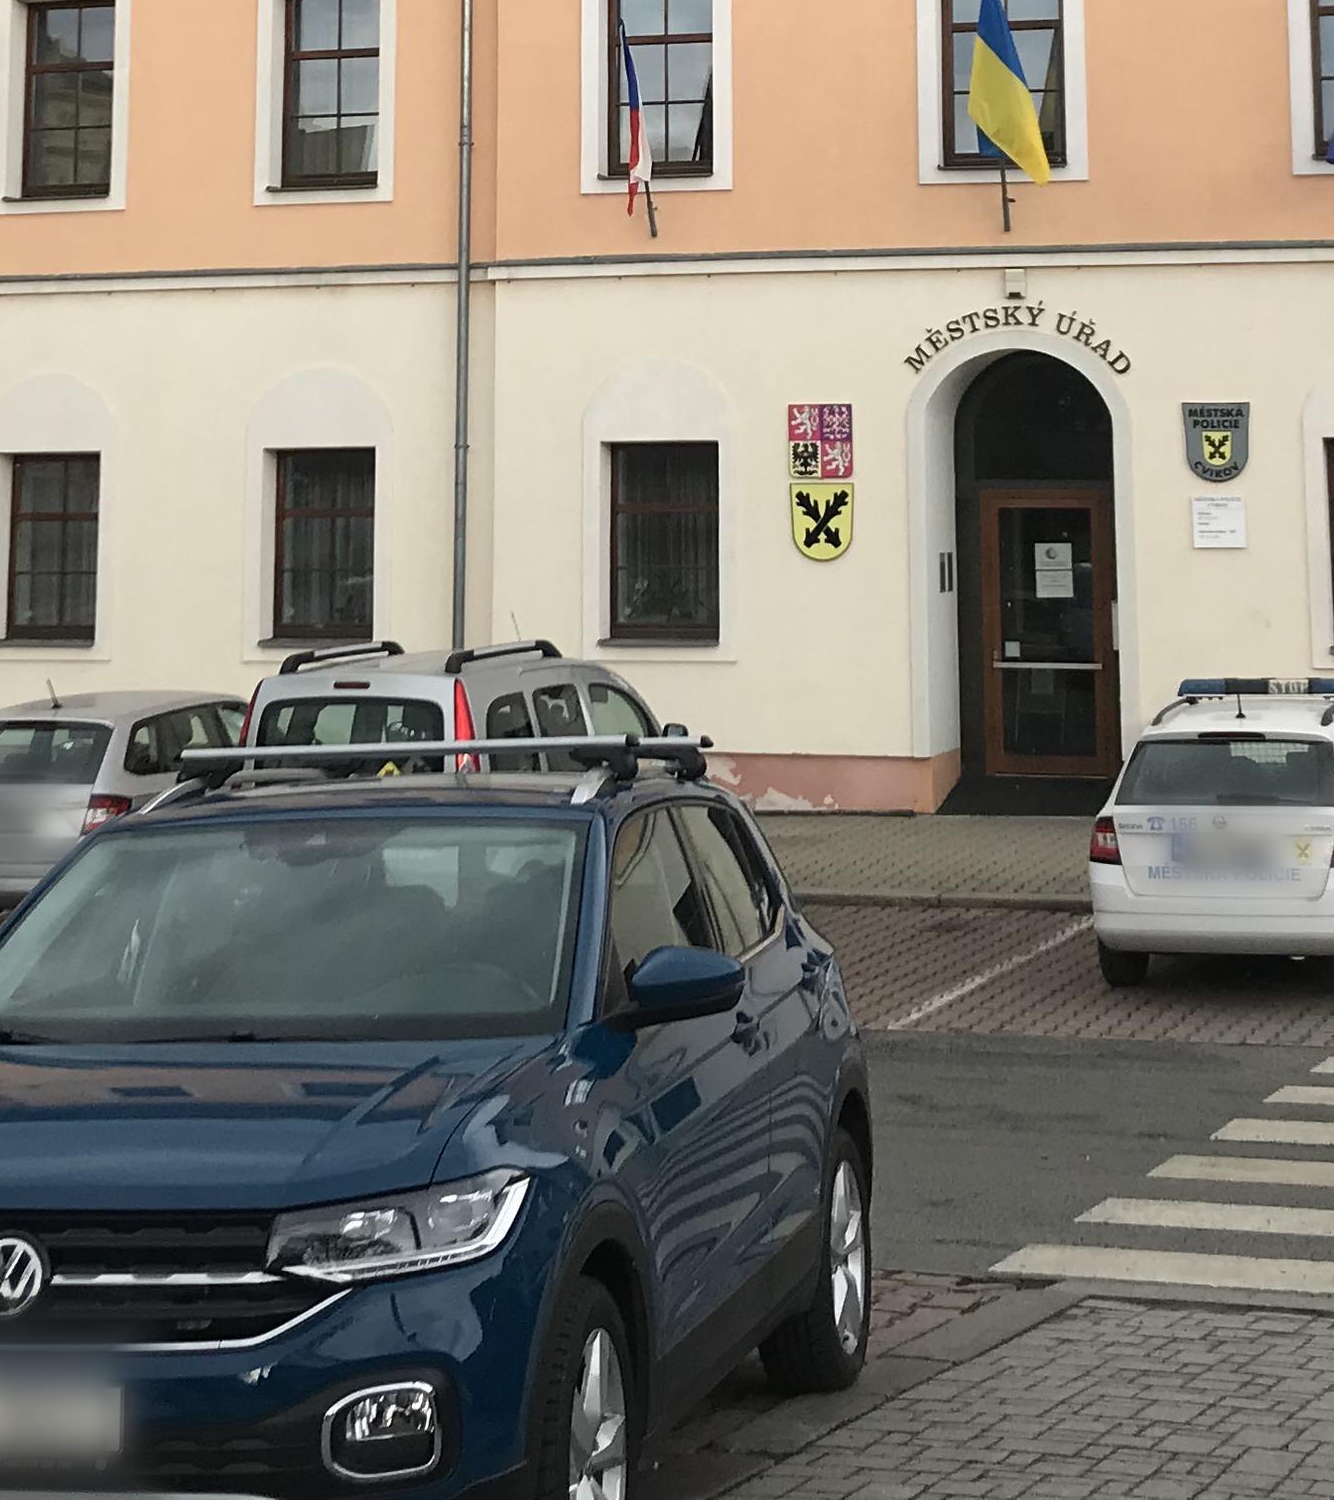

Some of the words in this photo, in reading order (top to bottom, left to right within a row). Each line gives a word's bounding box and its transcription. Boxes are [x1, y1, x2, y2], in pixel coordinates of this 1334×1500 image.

[904, 300, 1045, 374] MĚSTSKÝ
[1056, 310, 1132, 375] ÚŘAD
[1188, 405, 1245, 418] MĚSTSKÁ
[1192, 419, 1240, 430] POLICIE
[1194, 461, 1240, 478] CVIKOV
[1269, 679, 1309, 694] STOP
